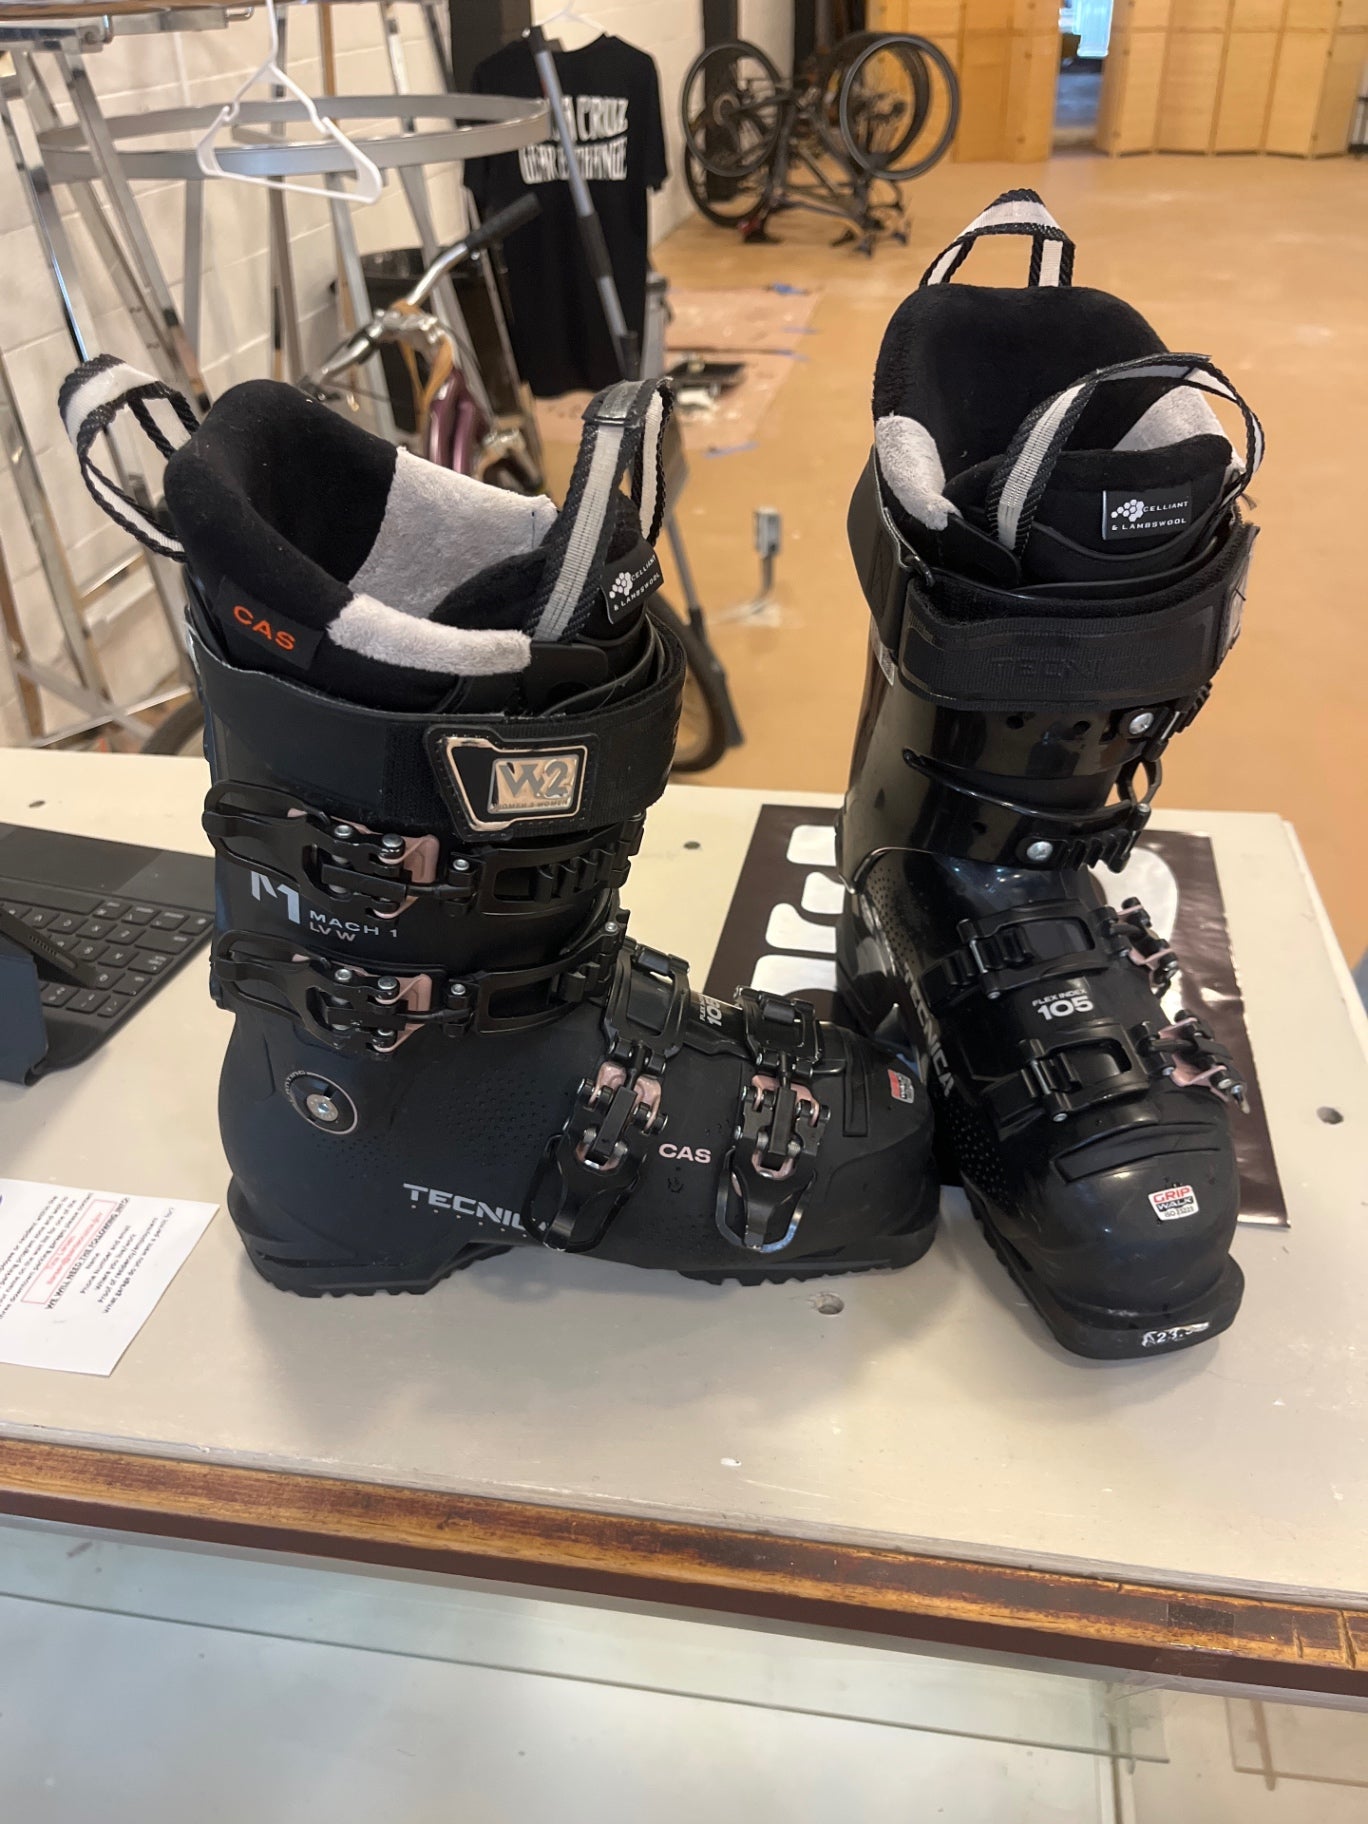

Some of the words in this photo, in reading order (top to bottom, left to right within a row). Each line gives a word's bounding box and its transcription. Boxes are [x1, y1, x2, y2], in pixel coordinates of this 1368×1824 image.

[576, 94, 629, 142] CRUZ
[1143, 500, 1189, 513] CELLIANT
[1121, 517, 1187, 530] LAMBSWOOL
[232, 604, 296, 651] CAS
[498, 760, 570, 799] W2
[309, 910, 379, 936] MACH
[390, 929, 398, 938] 1
[309, 921, 332, 936] LV
[336, 927, 356, 943] W
[1032, 994, 1058, 1007] FLEX
[1058, 988, 1087, 999] INDEX
[1037, 995, 1094, 1021] 105
[905, 962, 954, 1097] TECNICA
[658, 1143, 712, 1164] CAS
[403, 1182, 548, 1232] TECNI
[1153, 1187, 1191, 1203] GRIP
[1157, 1197, 1192, 1211] WALK
